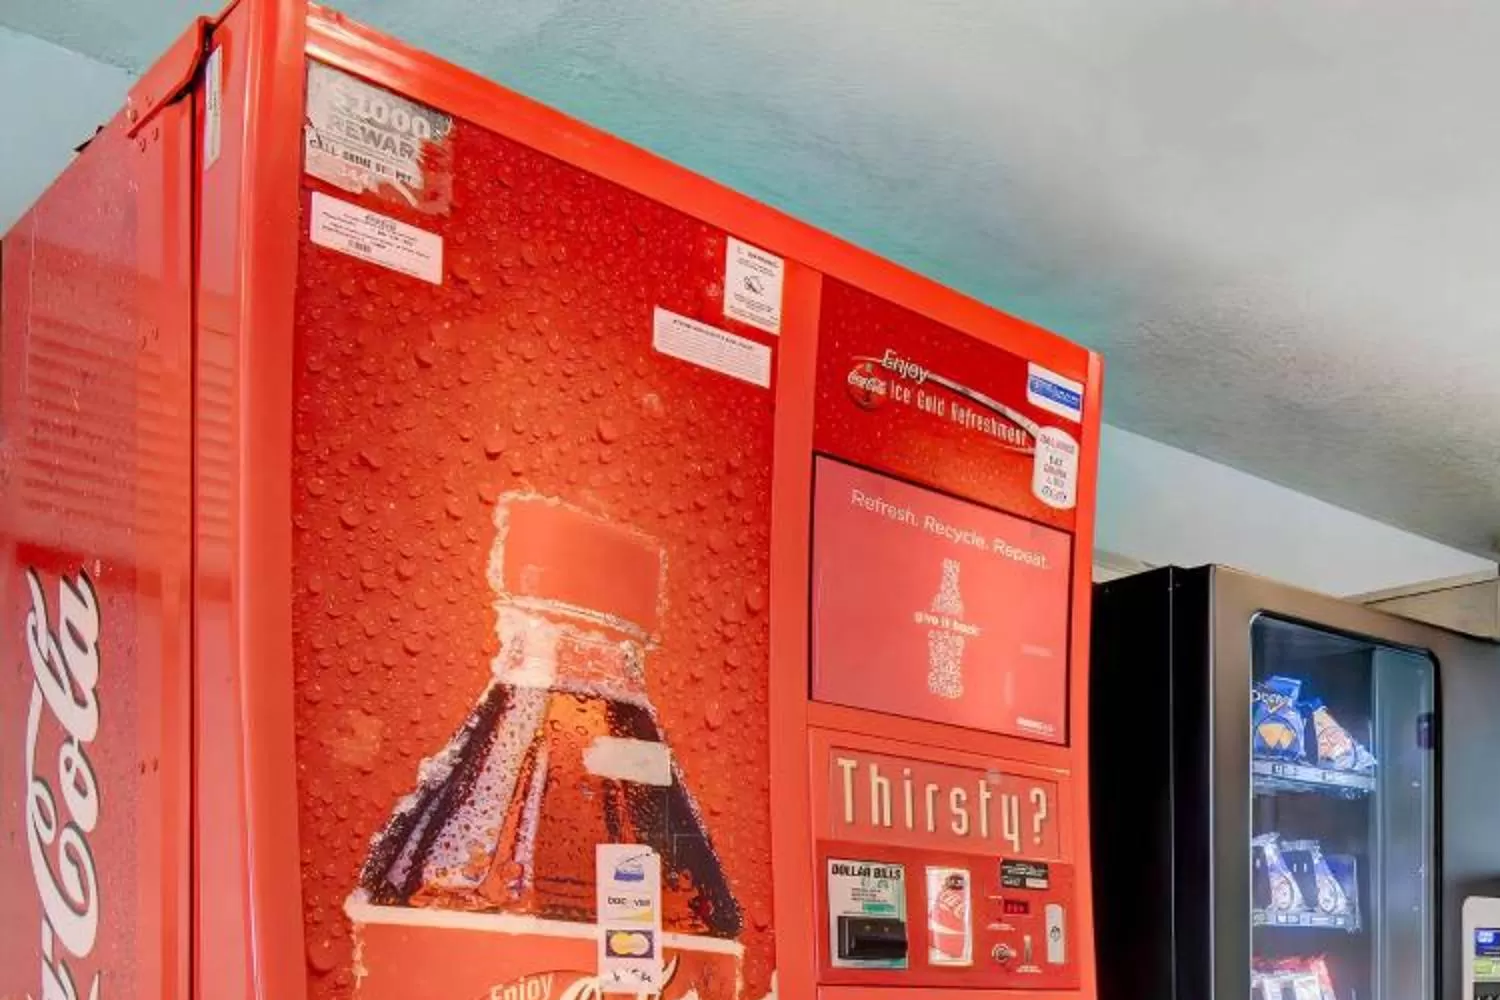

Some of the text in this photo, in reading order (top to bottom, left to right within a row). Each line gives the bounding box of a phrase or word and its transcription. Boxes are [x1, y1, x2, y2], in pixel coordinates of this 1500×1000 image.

[331, 112, 416, 161] REWAR
[881, 350, 928, 384] Enjoy
[890, 380, 911, 404] Ice
[917, 390, 945, 416] Cold
[951, 402, 1027, 447] Refreshment
[851, 488, 1050, 569] Refresh. Recycle. Repeat.
[837, 757, 1048, 853] Thirsty?
[832, 864, 901, 880] DOLLAR BILLS
